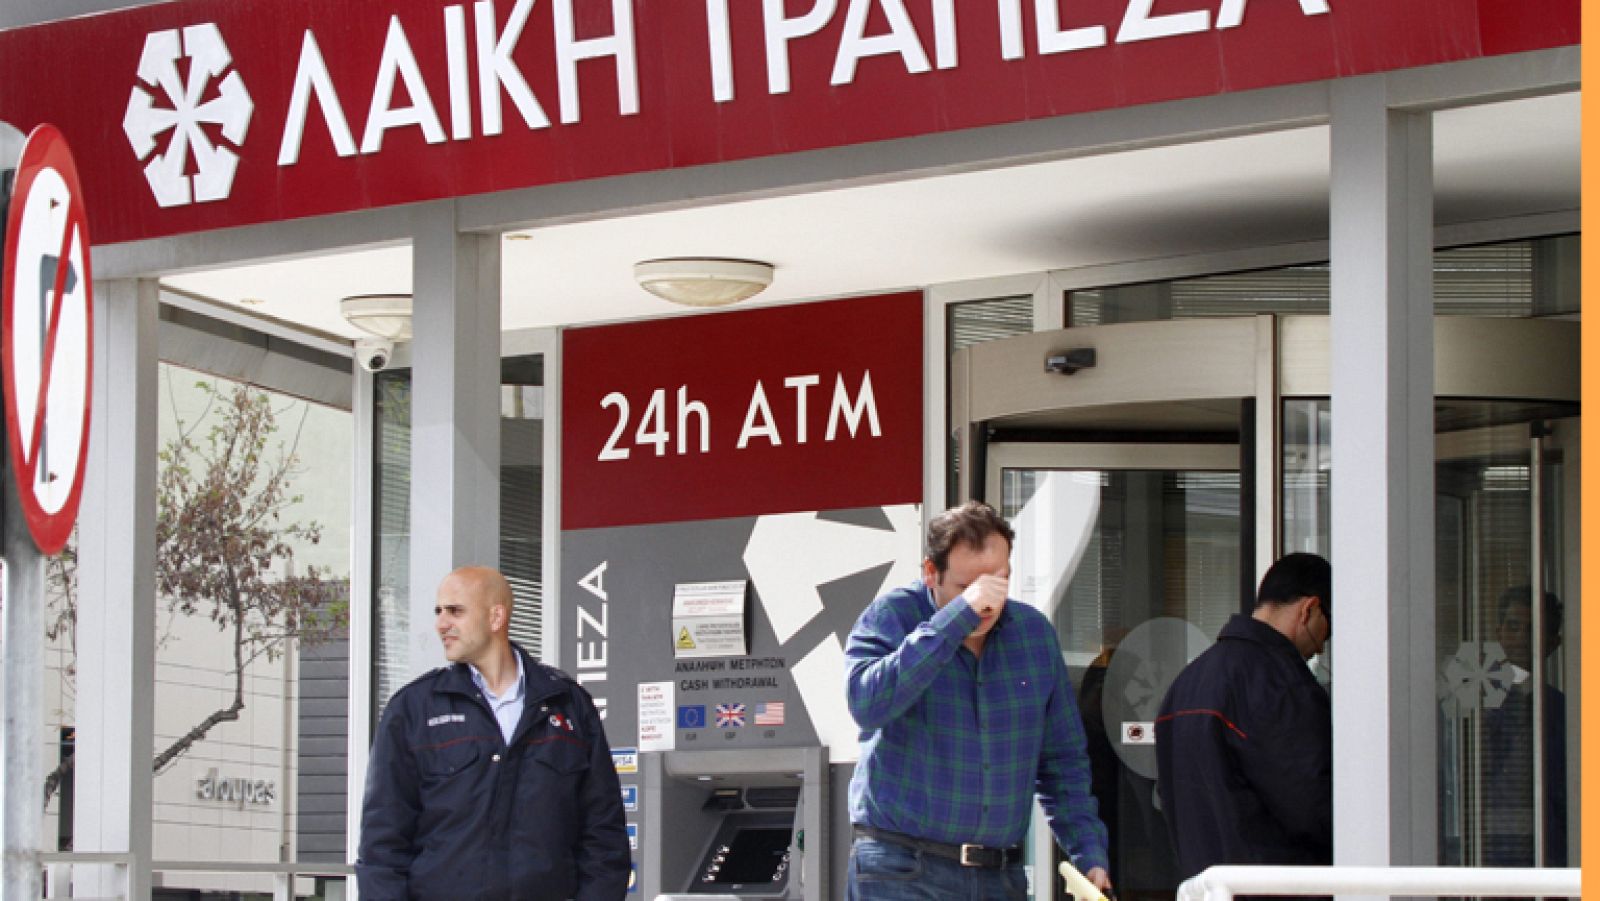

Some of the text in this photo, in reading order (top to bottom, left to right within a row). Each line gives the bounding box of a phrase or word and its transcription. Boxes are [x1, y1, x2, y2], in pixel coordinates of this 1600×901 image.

[597, 368, 882, 461] 24h ATM
[680, 677, 778, 691] CASH WITHDRAWAL
